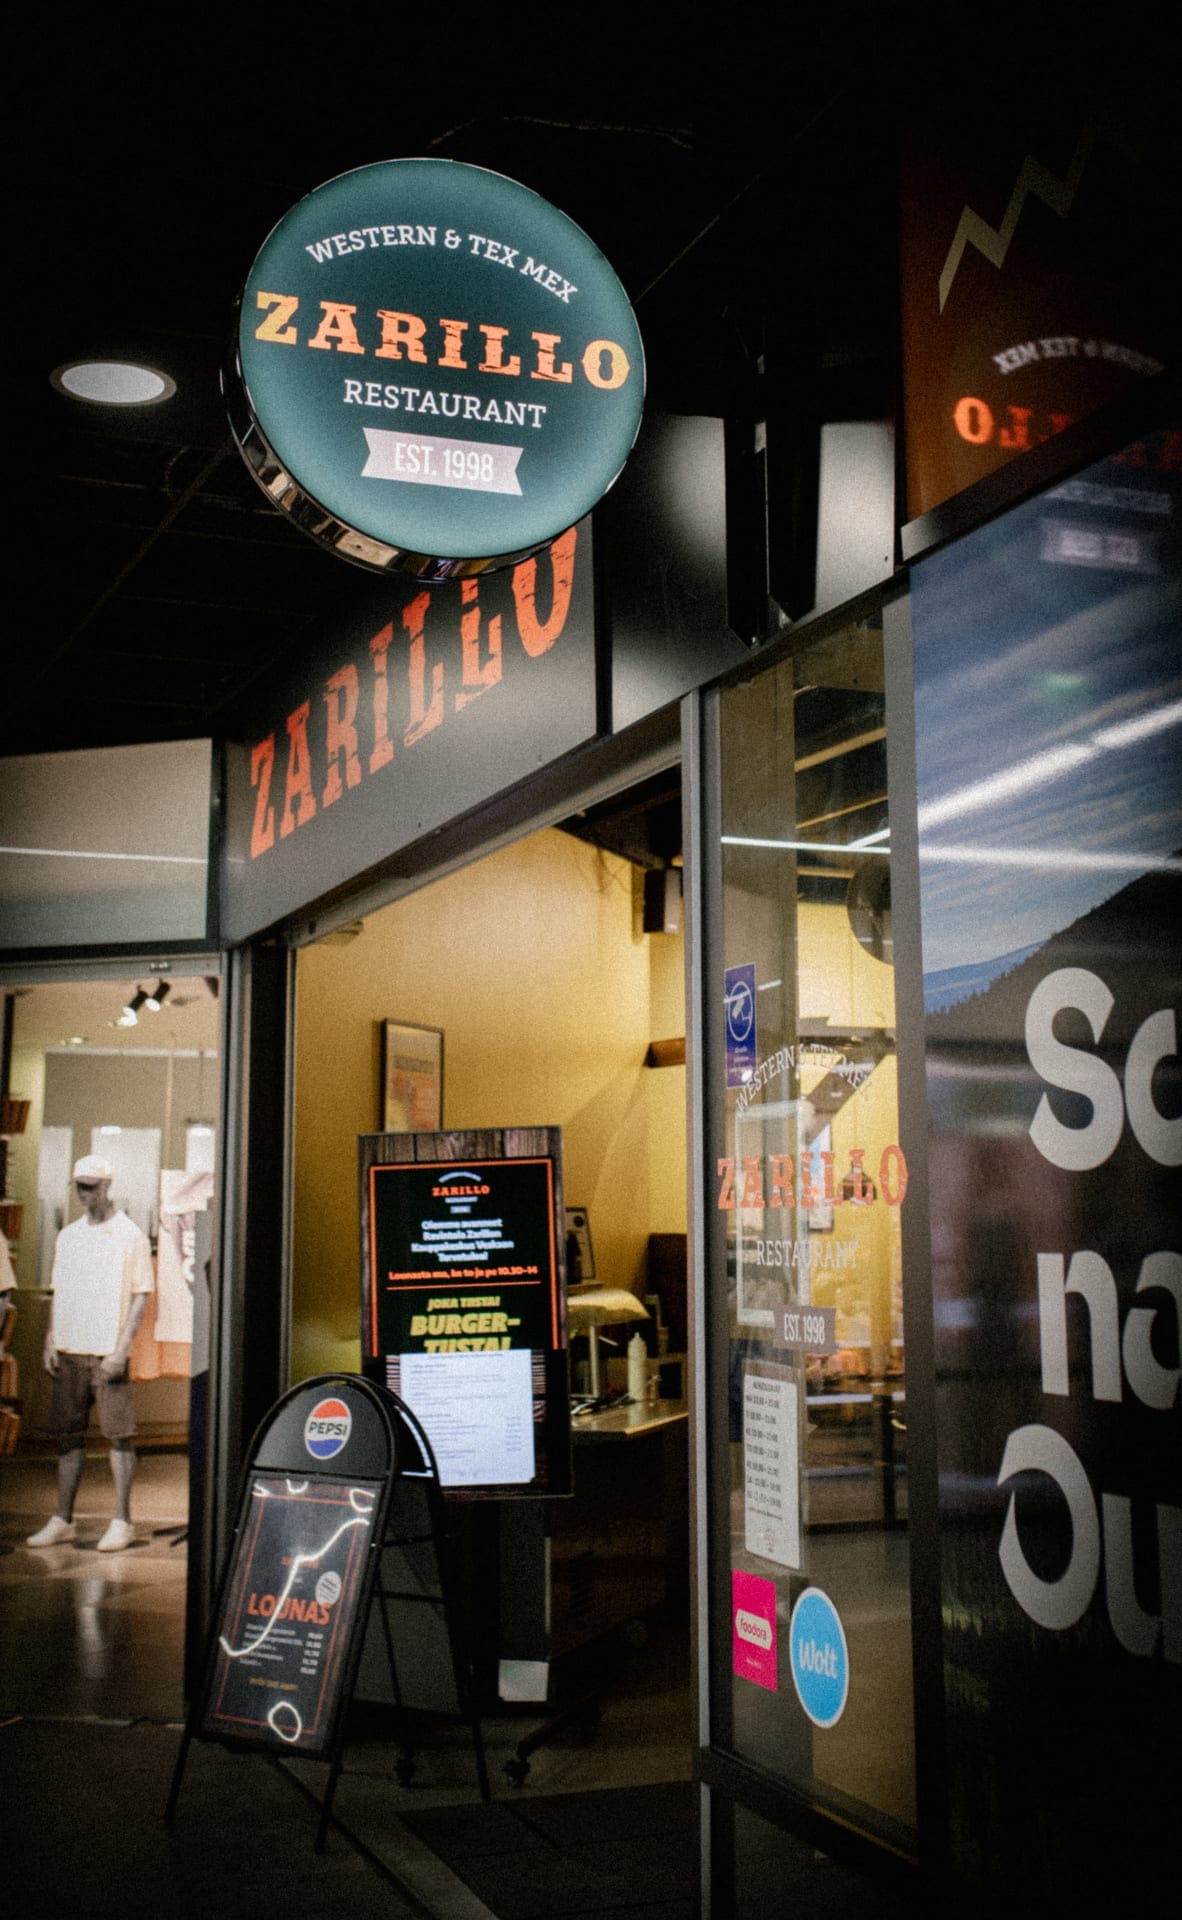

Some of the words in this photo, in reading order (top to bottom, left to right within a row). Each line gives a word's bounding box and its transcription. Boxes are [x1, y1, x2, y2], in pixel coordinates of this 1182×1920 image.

[305, 225, 437, 264] WESTERN
[444, 228, 462, 250] &
[469, 234, 521, 268] TEX
[522, 257, 579, 304] MEX
[255, 290, 631, 390] ZARILLO
[343, 378, 547, 429] RESTAURANT
[394, 441, 438, 478] EST.
[443, 449, 494, 483] 1998
[249, 526, 578, 860] ZARILLO
[431, 1185, 490, 1197] ZARILLO
[716, 1144, 909, 1210] ZARILLO
[756, 1238, 860, 1271] RESTAURANT
[410, 1312, 521, 1336] BURGER-
[801, 1313, 826, 1345] 1998
[308, 1420, 348, 1436] PEPSI
[247, 1592, 331, 1625] LOUNAS
[740, 1618, 767, 1641] foodora
[799, 1638, 838, 1679] Wolt
